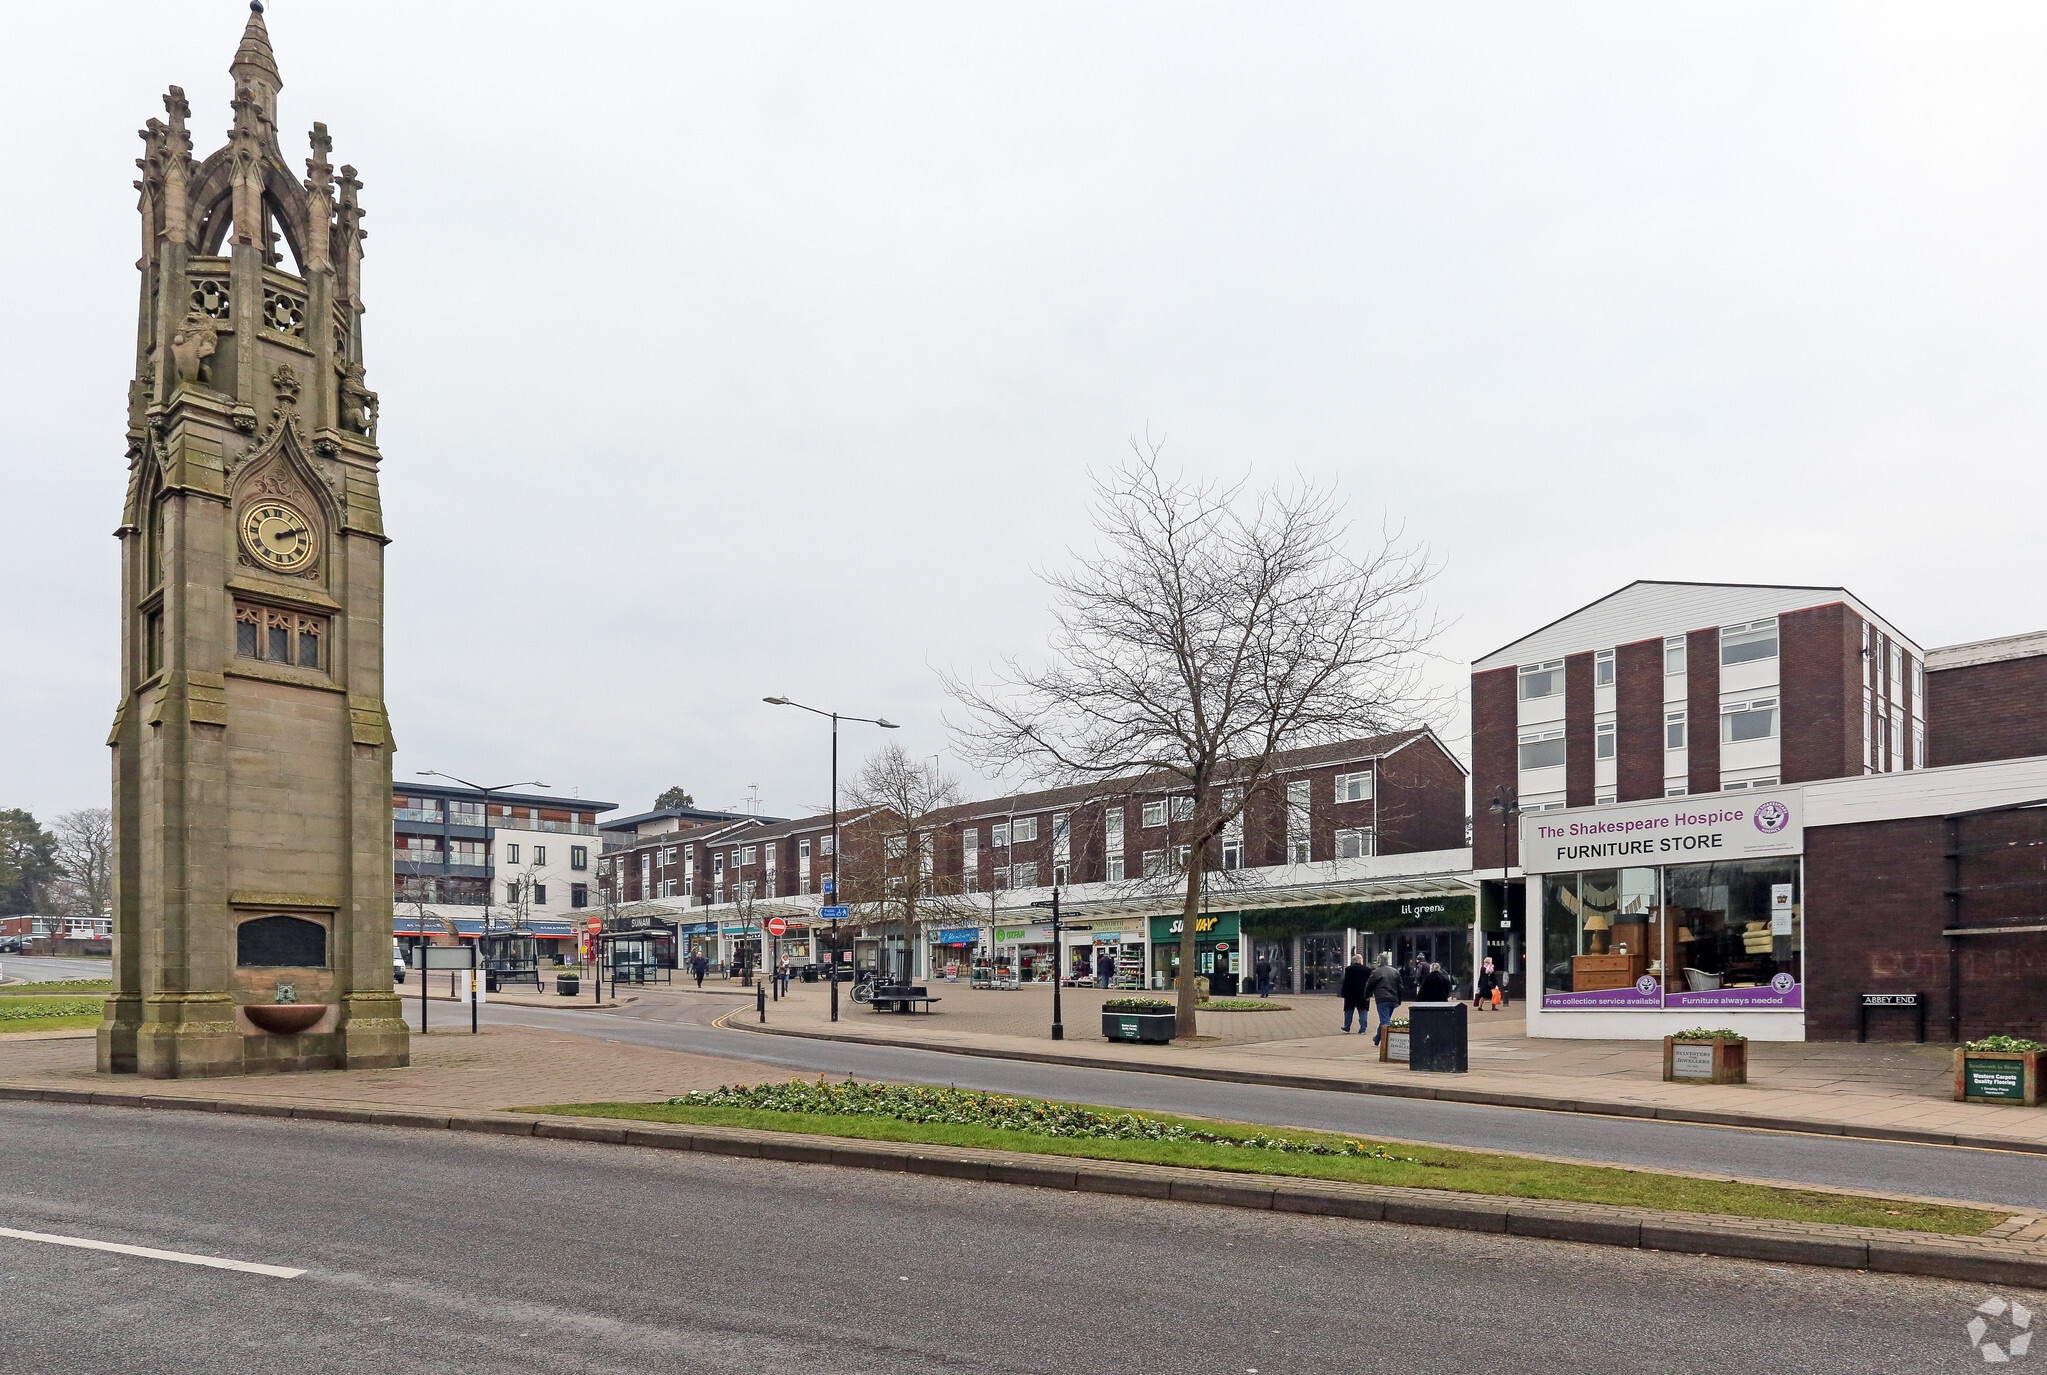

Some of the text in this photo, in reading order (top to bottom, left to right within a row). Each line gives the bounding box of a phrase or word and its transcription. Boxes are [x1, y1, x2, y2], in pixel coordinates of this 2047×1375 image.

[1538, 808, 1745, 839] The Shakespeare Hospice
[1557, 833, 1723, 861] FURNITURE STORE
[1413, 904, 1445, 919] greens
[631, 917, 651, 928] SUNAM
[1006, 930, 1025, 939] OXFAM
[1720, 997, 1749, 1006] always
[1865, 996, 1915, 1004] ABBEY END
